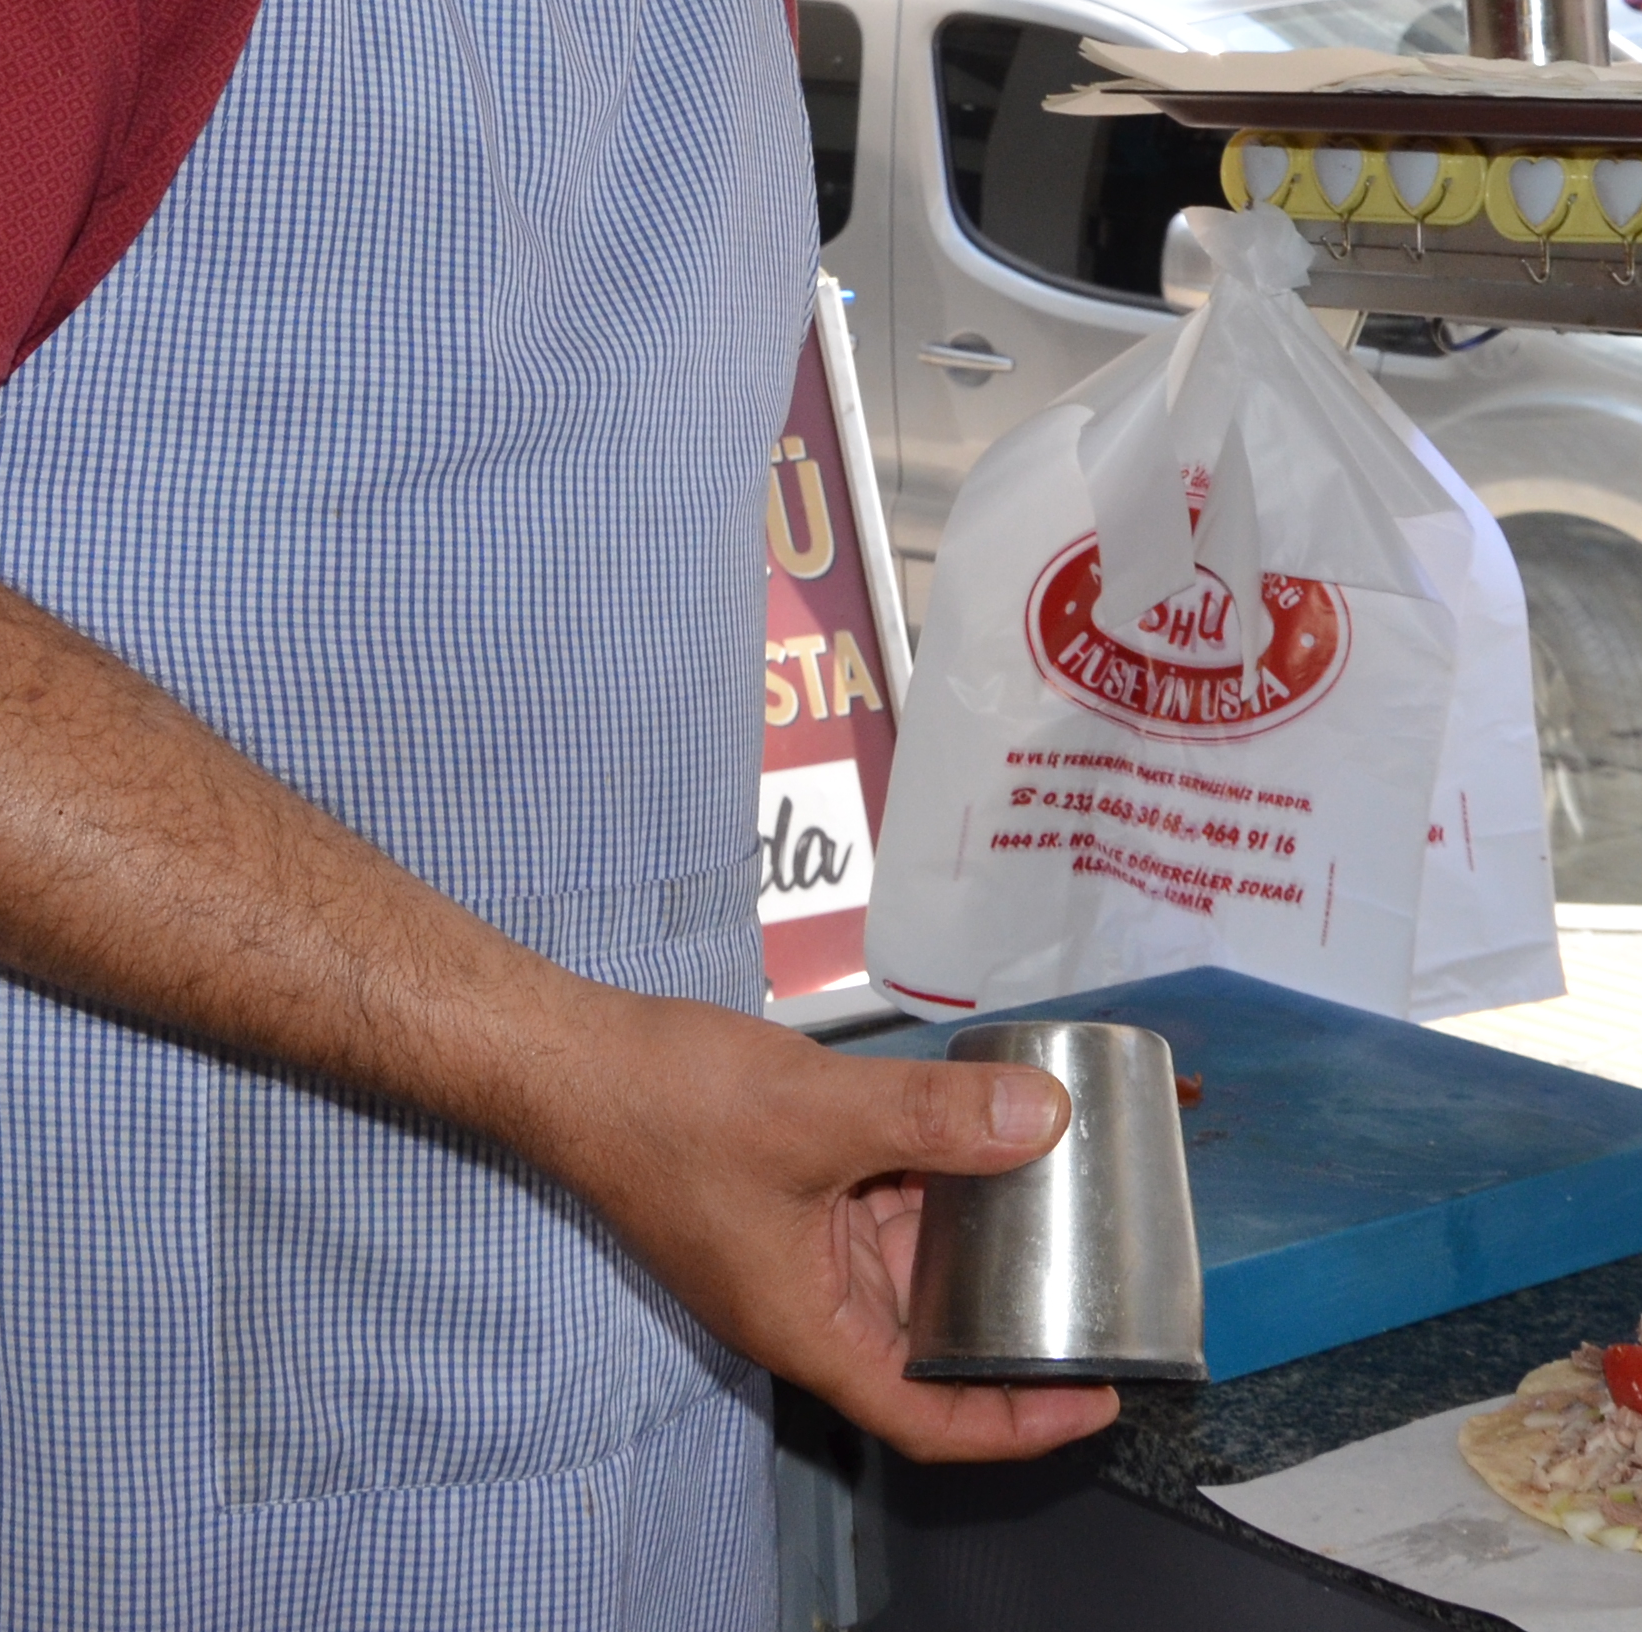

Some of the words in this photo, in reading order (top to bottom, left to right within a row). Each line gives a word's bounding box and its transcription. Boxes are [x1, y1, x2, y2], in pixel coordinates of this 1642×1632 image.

[1057, 630, 1197, 721] HÜSEYİN
[1006, 751, 1025, 765] EV
[1027, 751, 1043, 765] VE
[1178, 772, 1253, 802] SERVİSİMİZ
[1097, 795, 1133, 821] 463
[1136, 805, 1161, 827] 30
[1161, 810, 1184, 834] 68
[1200, 821, 1241, 847] 464
[1246, 829, 1270, 851] 91
[1274, 832, 1296, 856] 16
[989, 833, 1033, 850] 1444
[1127, 852, 1233, 895] DÖNERCİLER
[1236, 875, 1305, 905] SOKAĞI
[1163, 885, 1215, 916] İZMİR
